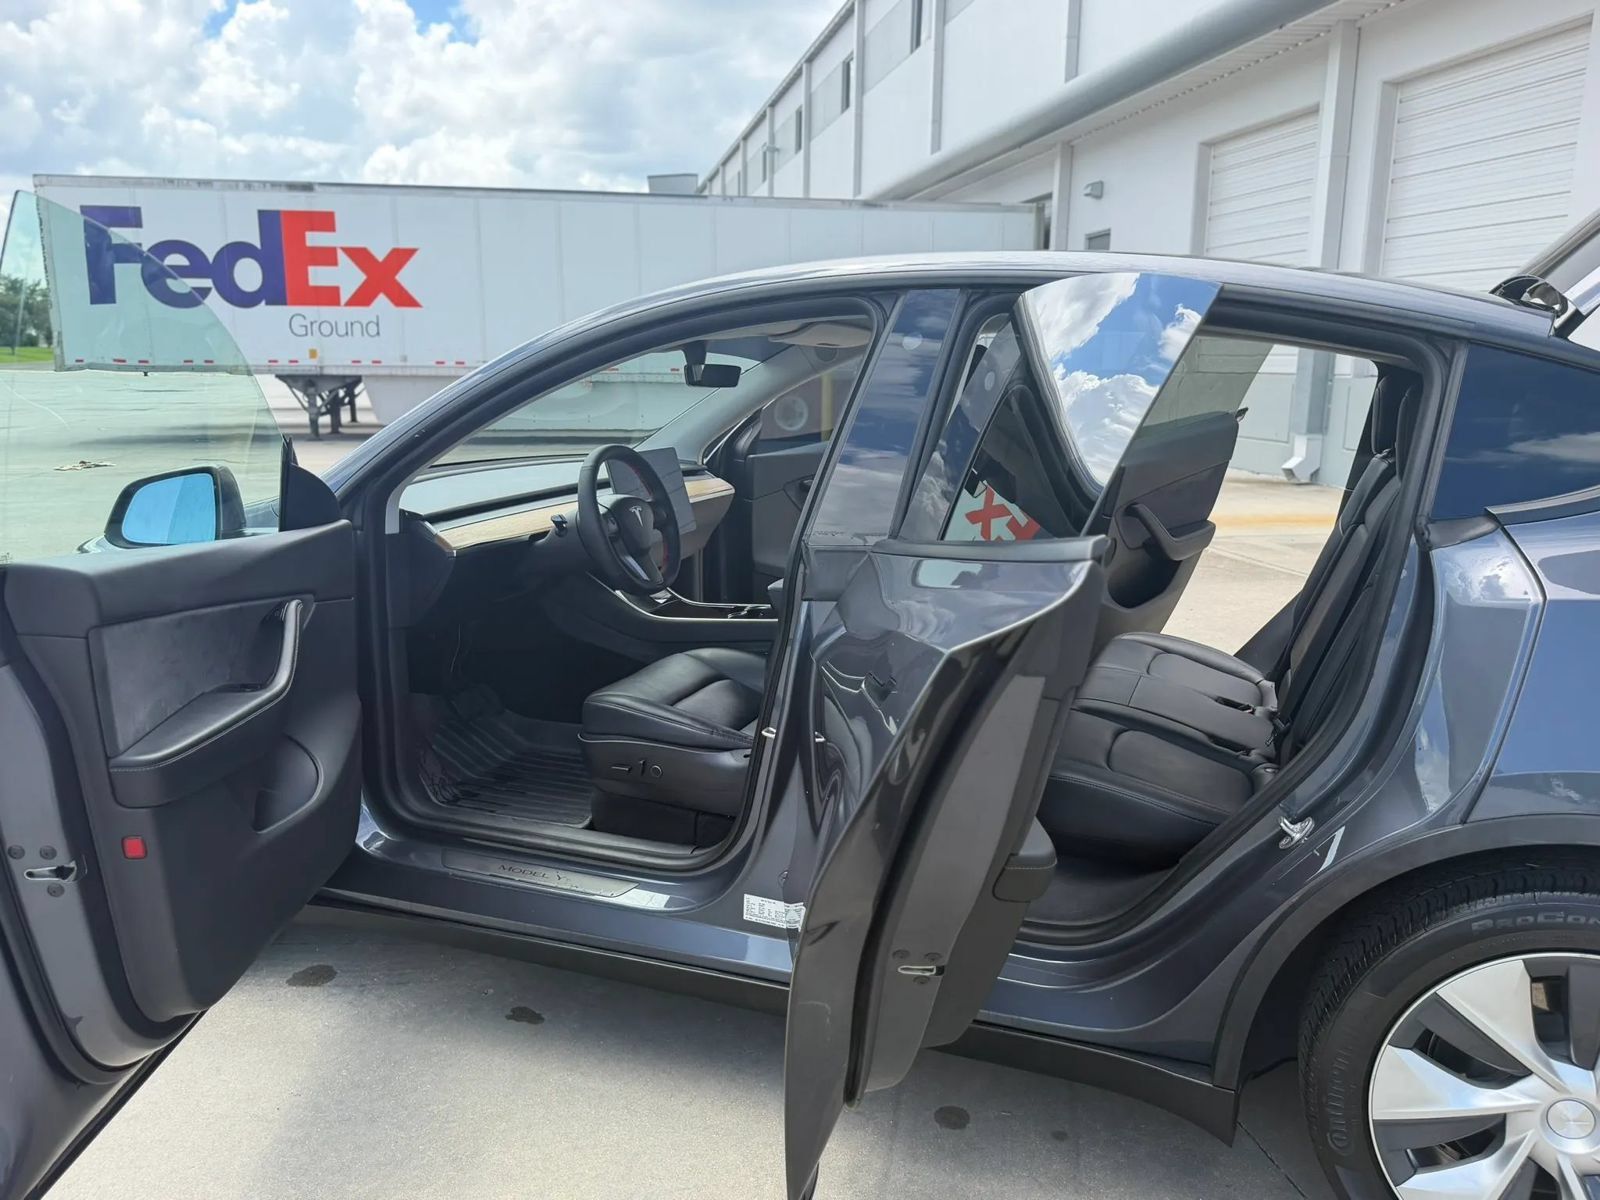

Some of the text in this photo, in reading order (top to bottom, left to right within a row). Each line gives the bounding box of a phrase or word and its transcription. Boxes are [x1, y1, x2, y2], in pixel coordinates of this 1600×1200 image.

[80, 205, 423, 309] FedEx
[288, 313, 380, 338] Ground
[499, 864, 549, 879] MODEL
